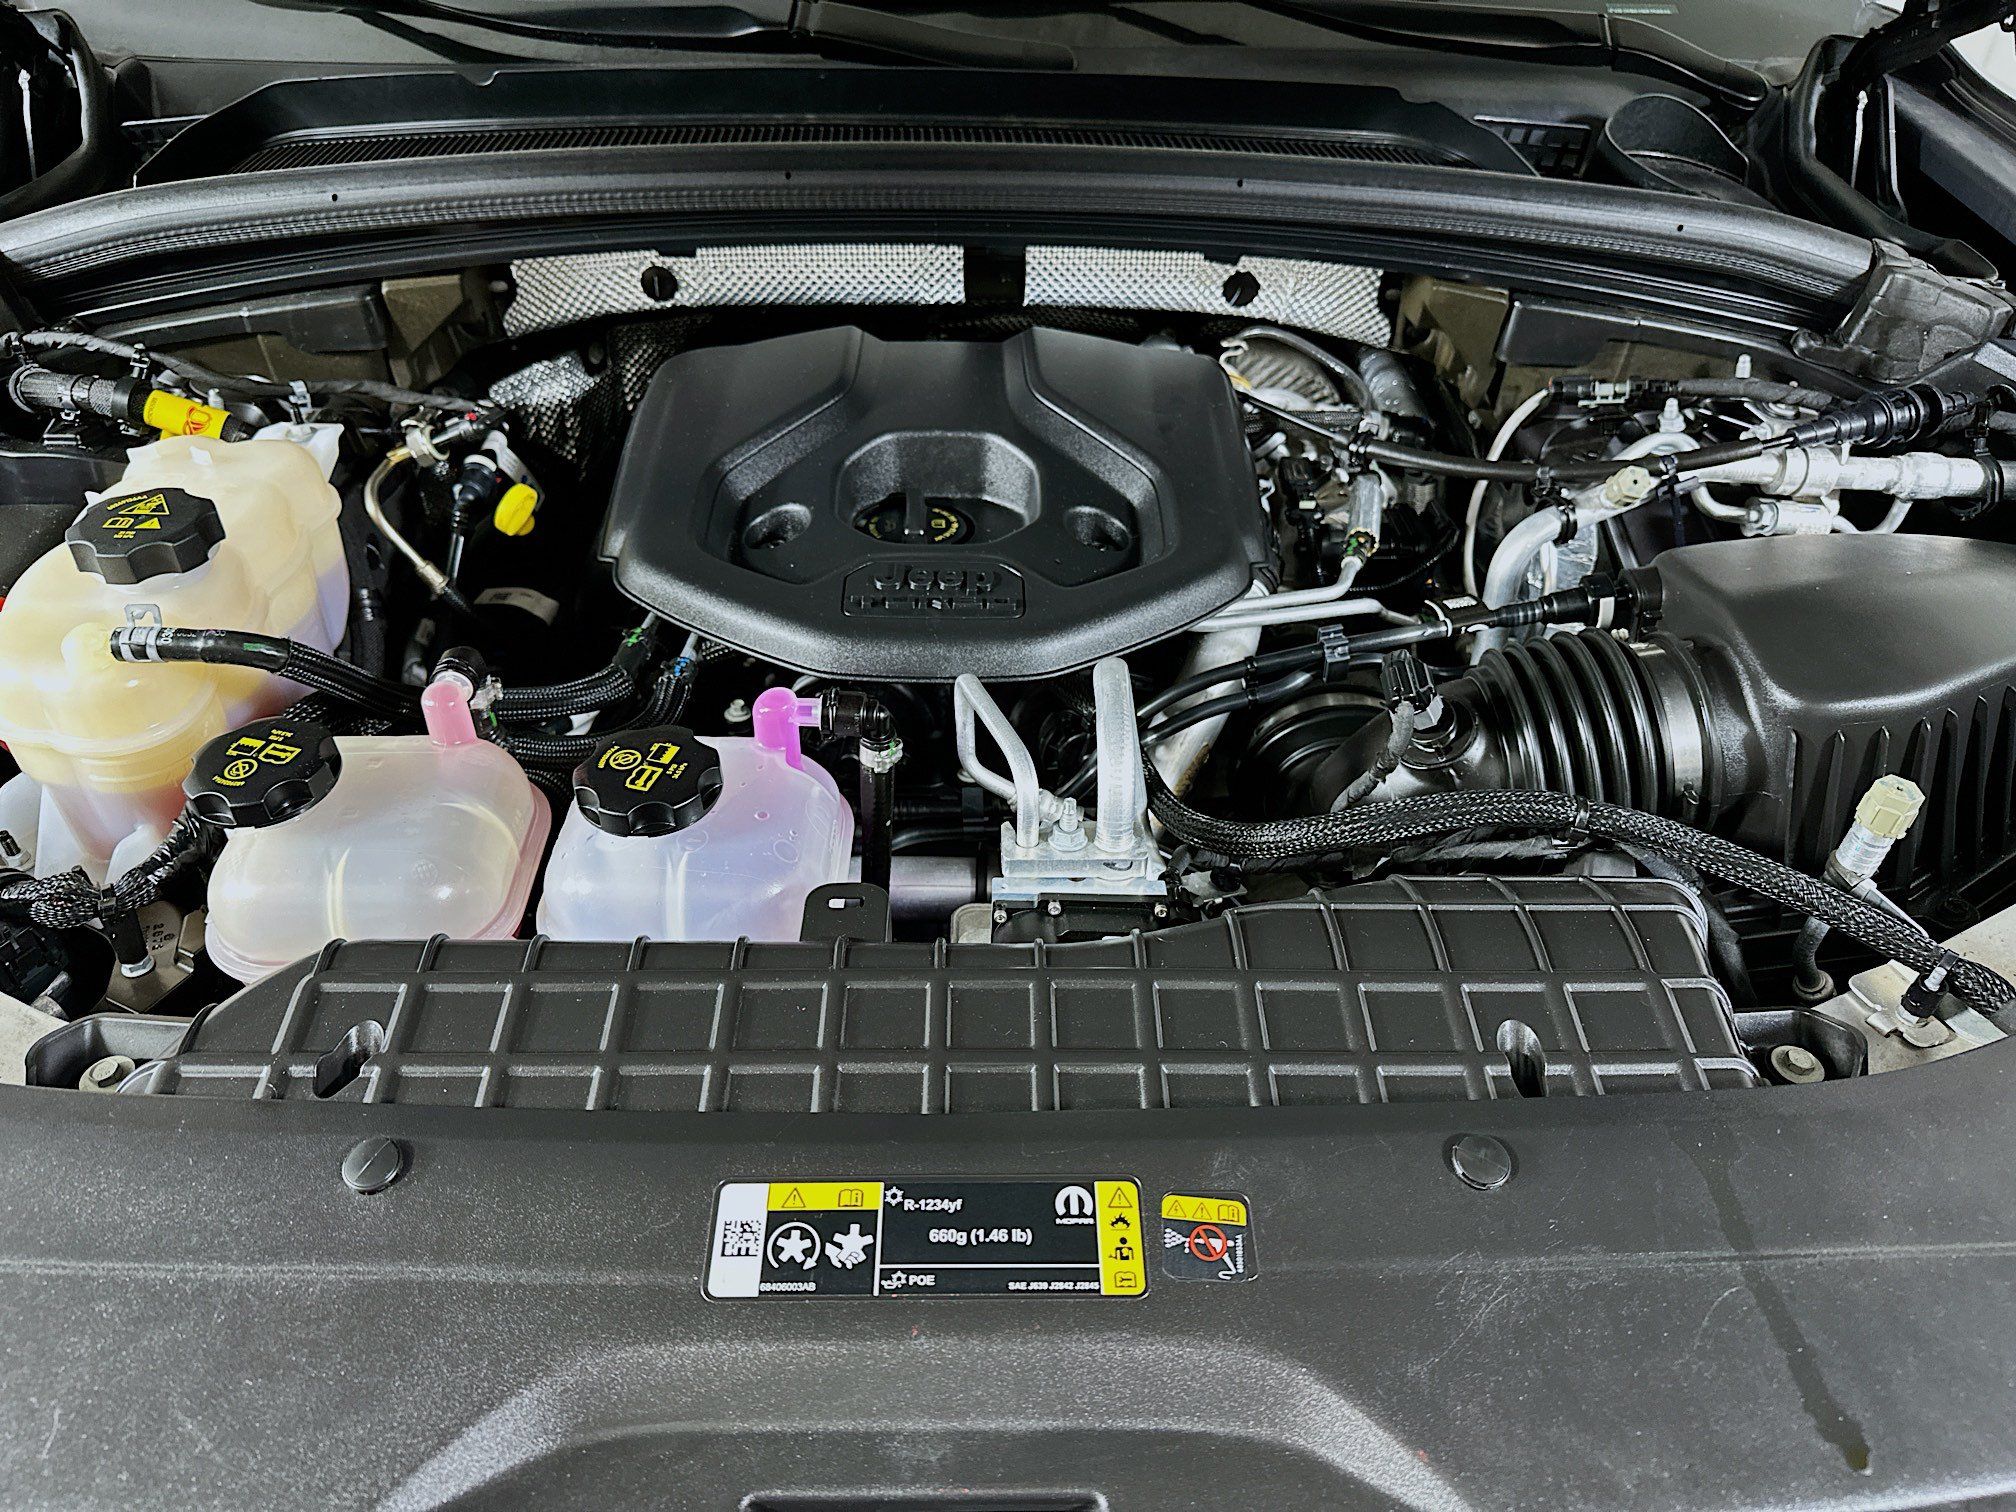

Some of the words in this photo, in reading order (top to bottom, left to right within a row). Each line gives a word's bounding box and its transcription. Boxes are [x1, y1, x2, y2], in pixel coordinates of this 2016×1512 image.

[904, 1198, 963, 1214] R-1234yf
[1055, 1217, 1095, 1225] MOPAR
[928, 1228, 968, 1246] 660g
[970, 1228, 1009, 1246] (1.46
[1011, 1228, 1033, 1246] lb)
[908, 1275, 936, 1286] POE
[1008, 1281, 1028, 1290] SAE
